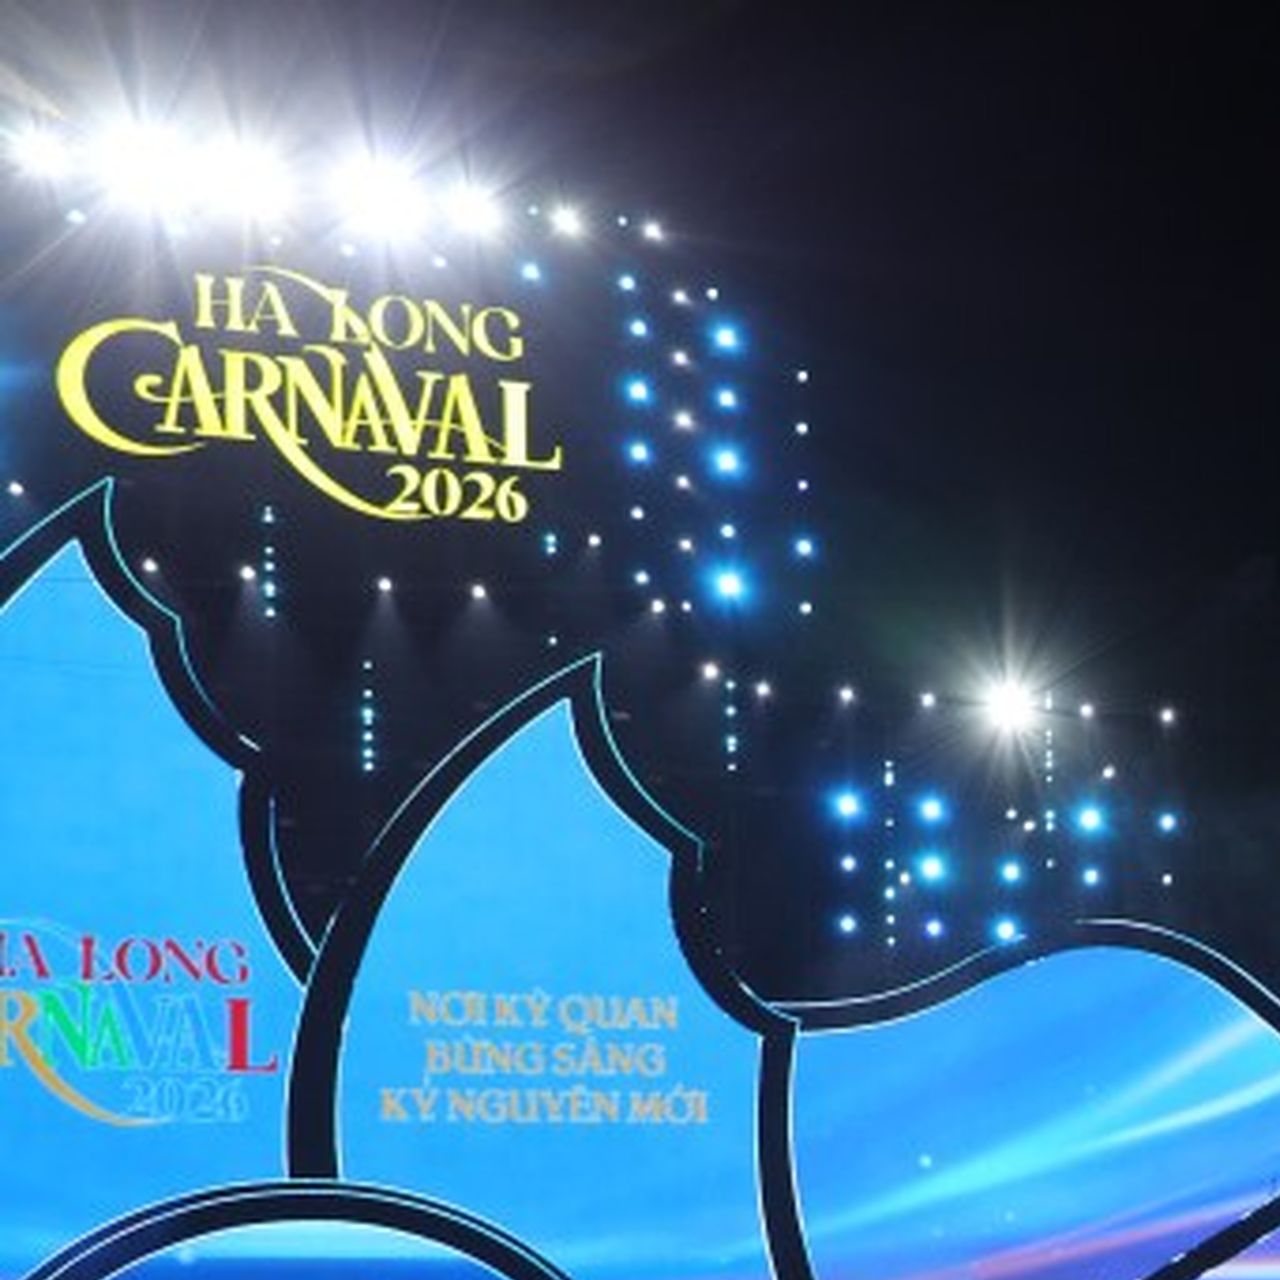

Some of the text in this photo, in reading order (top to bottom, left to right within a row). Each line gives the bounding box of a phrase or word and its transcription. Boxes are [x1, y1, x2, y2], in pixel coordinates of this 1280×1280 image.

[329, 286, 525, 362] LONG
[55, 316, 563, 510] CARNAVAL
[384, 463, 529, 524] 2026
[80, 935, 250, 985] LONG
[559, 991, 679, 1037] QUAN
[122, 1073, 250, 1124] 2026
[448, 1083, 622, 1125] NGUYÊN
